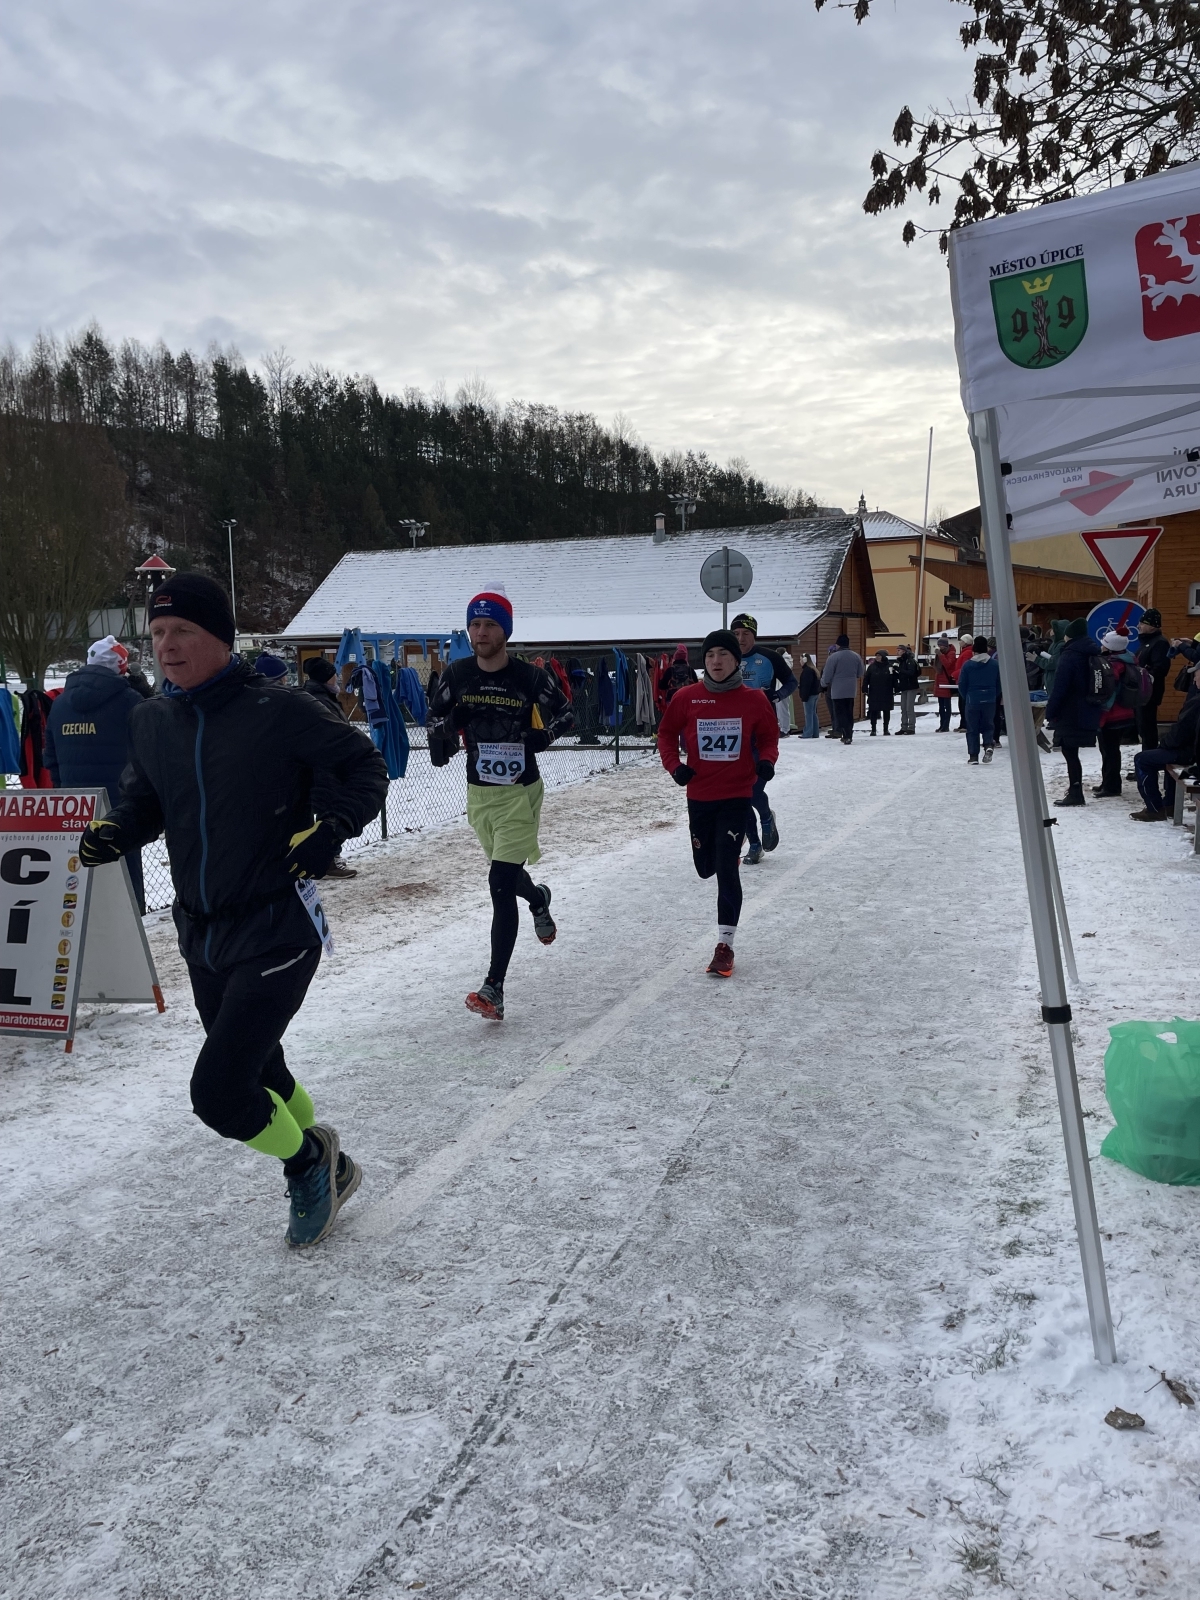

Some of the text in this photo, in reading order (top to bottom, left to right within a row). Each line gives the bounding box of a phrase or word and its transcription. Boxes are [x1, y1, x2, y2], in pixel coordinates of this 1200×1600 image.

[989, 244, 1084, 277] MĚSTO ÚPICE
[461, 695, 523, 708] RUNMAGEDDON
[62, 722, 97, 736] CZECHIA
[701, 735, 739, 752] 247
[480, 759, 522, 777] 309
